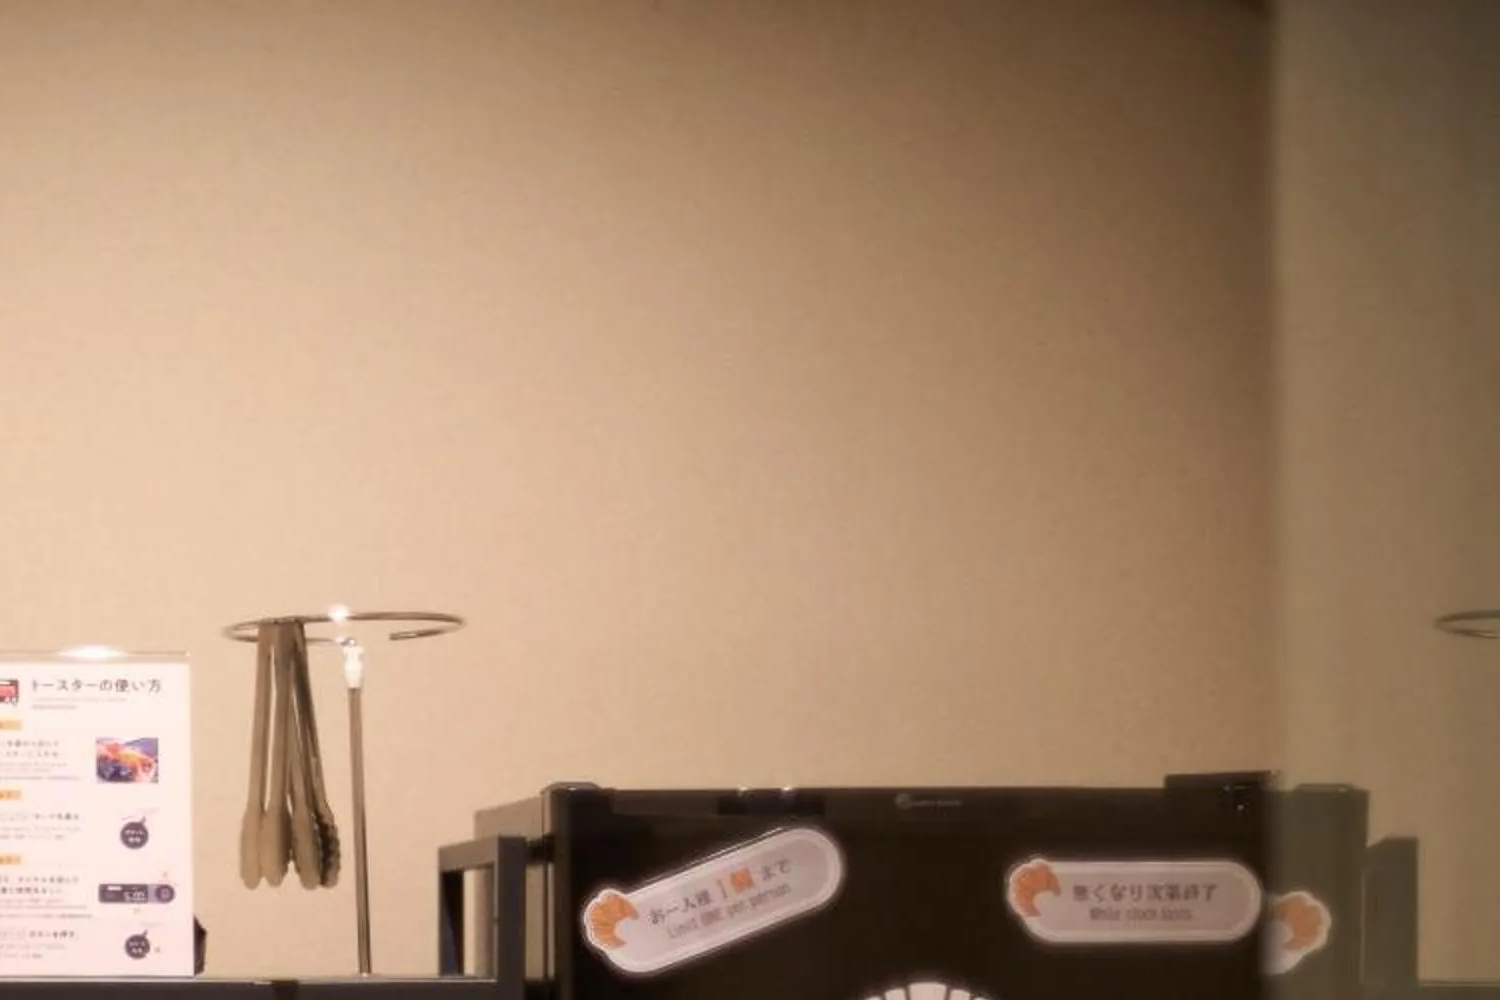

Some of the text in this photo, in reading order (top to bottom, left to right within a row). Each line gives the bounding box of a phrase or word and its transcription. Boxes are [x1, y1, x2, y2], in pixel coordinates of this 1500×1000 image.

[31, 678, 161, 693] トースターの使い方
